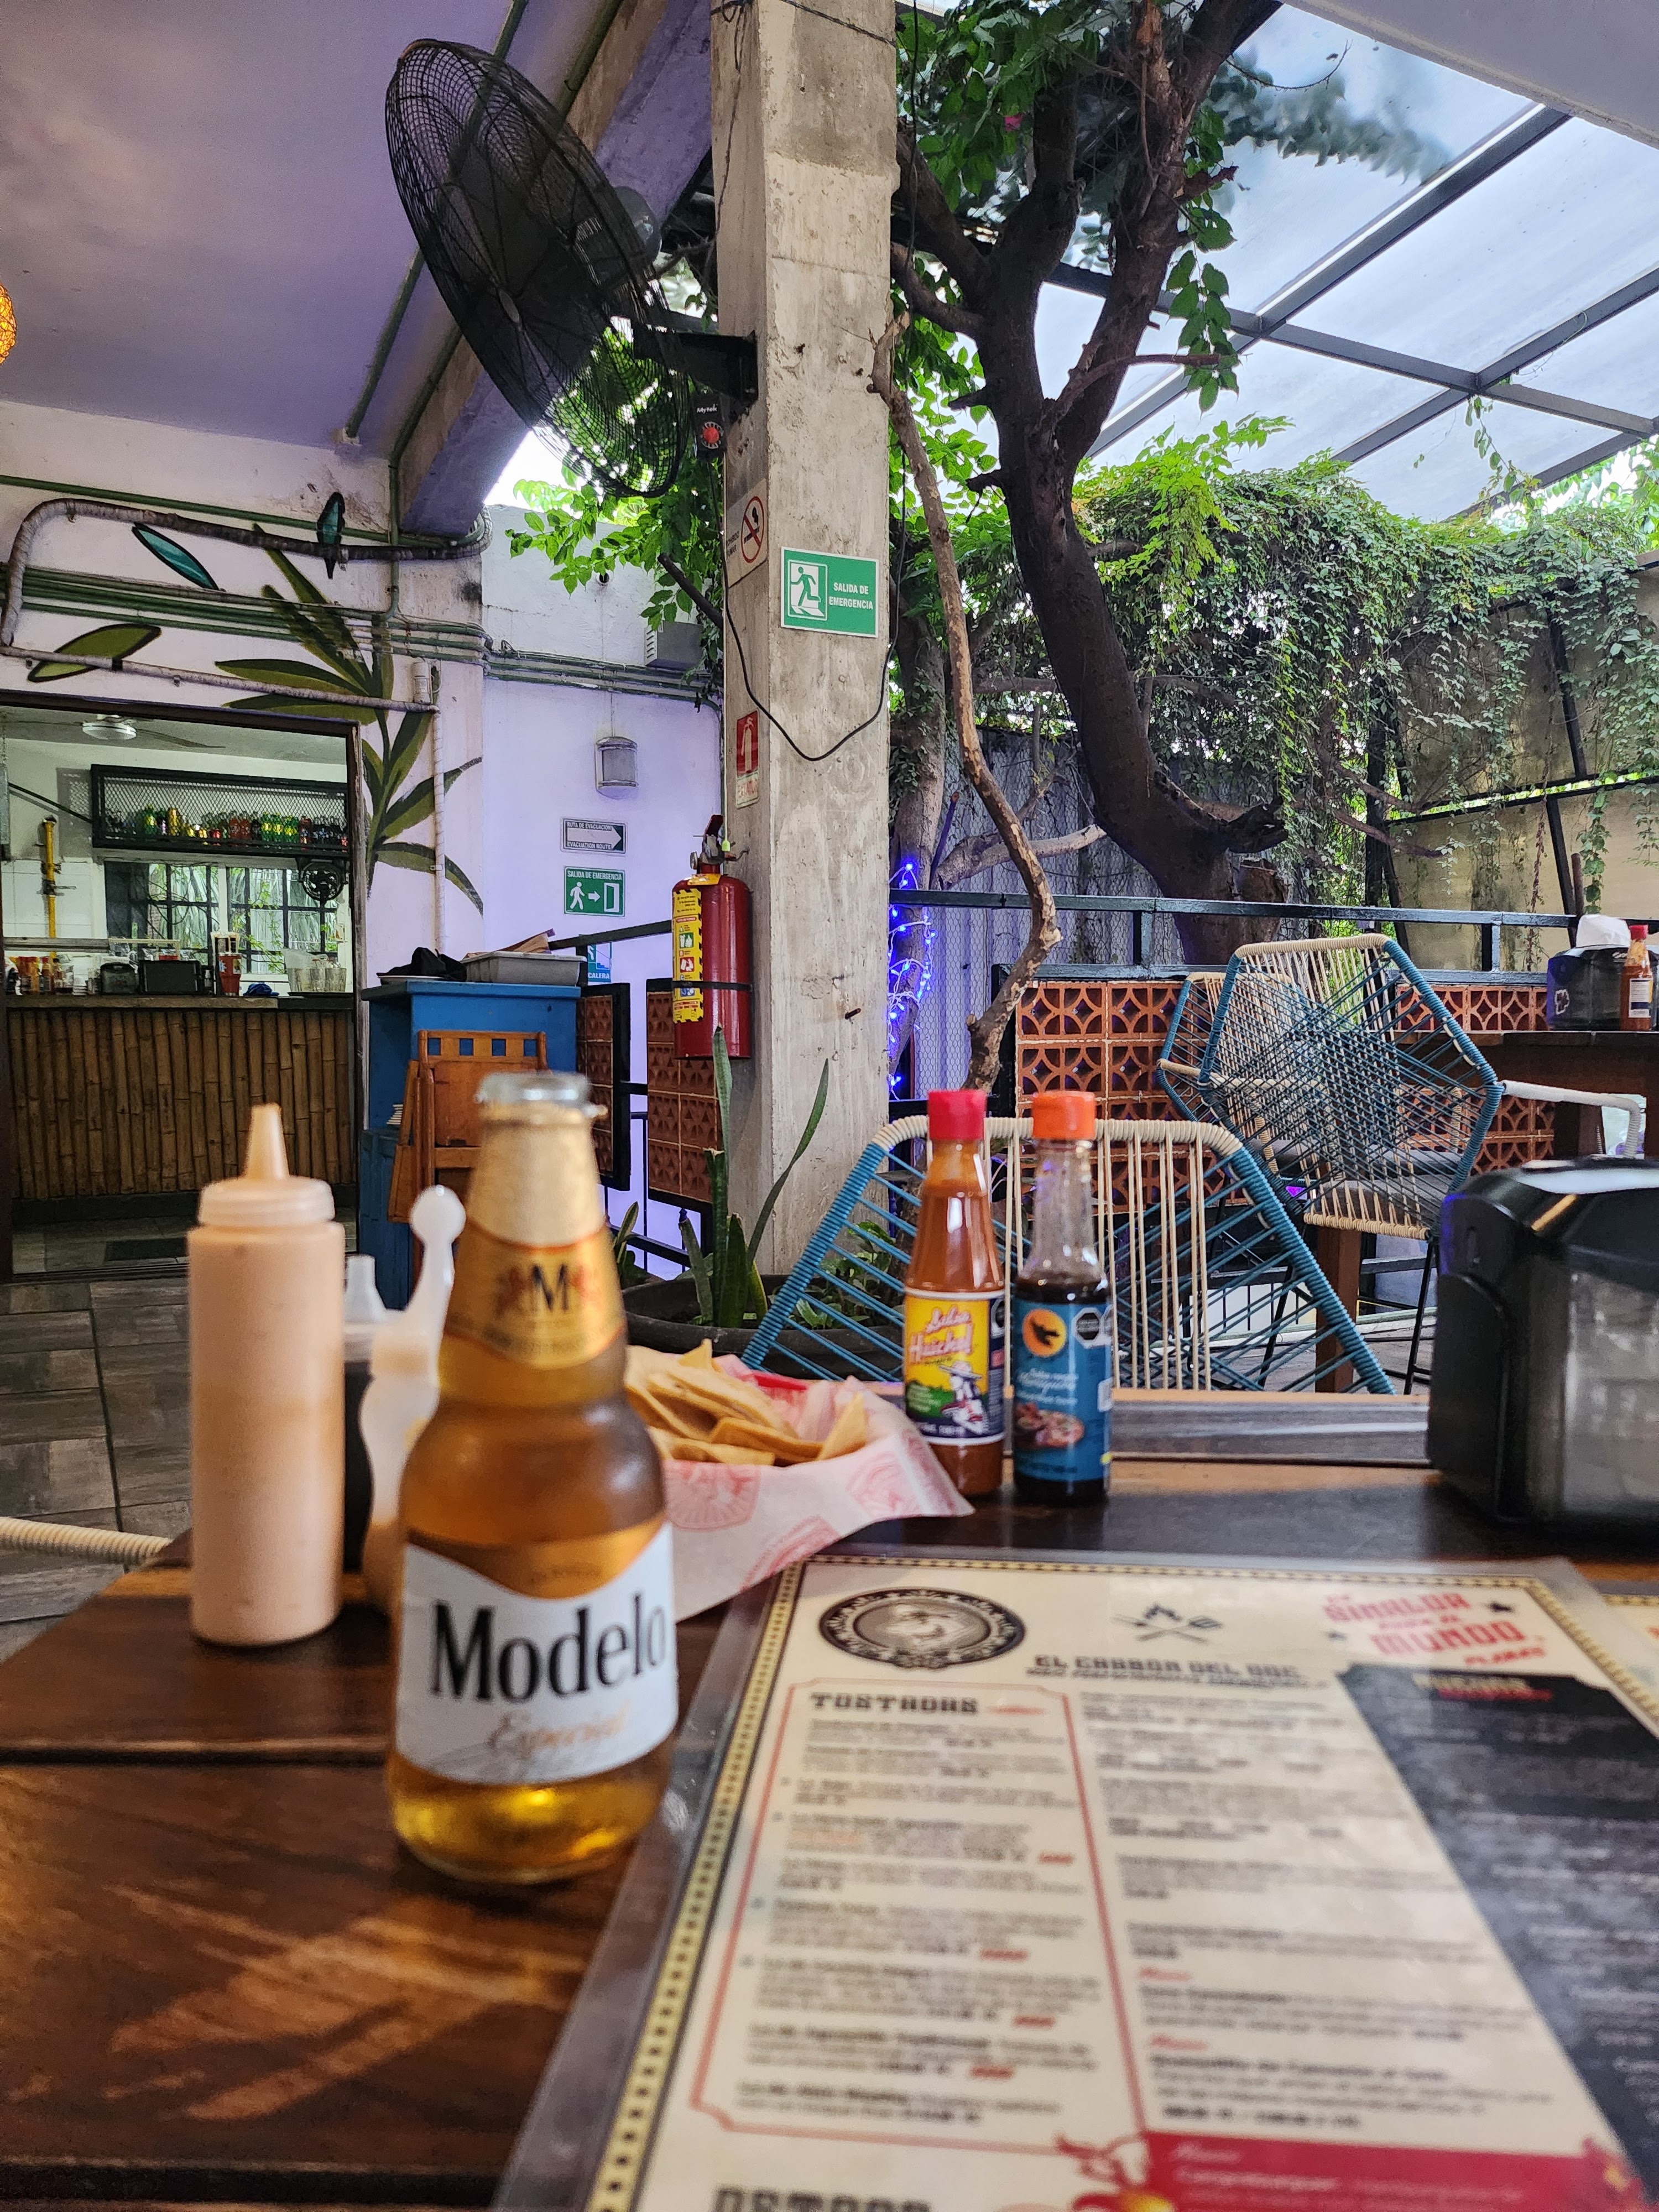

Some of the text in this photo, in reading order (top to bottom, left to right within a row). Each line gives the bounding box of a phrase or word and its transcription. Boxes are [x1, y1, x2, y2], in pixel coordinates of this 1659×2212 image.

[833, 582, 869, 594] SALIDA DE
[829, 596, 873, 610] EMERGENCIA
[592, 872, 622, 881] EMERGENCIA
[431, 1592, 666, 1702] Modelo
